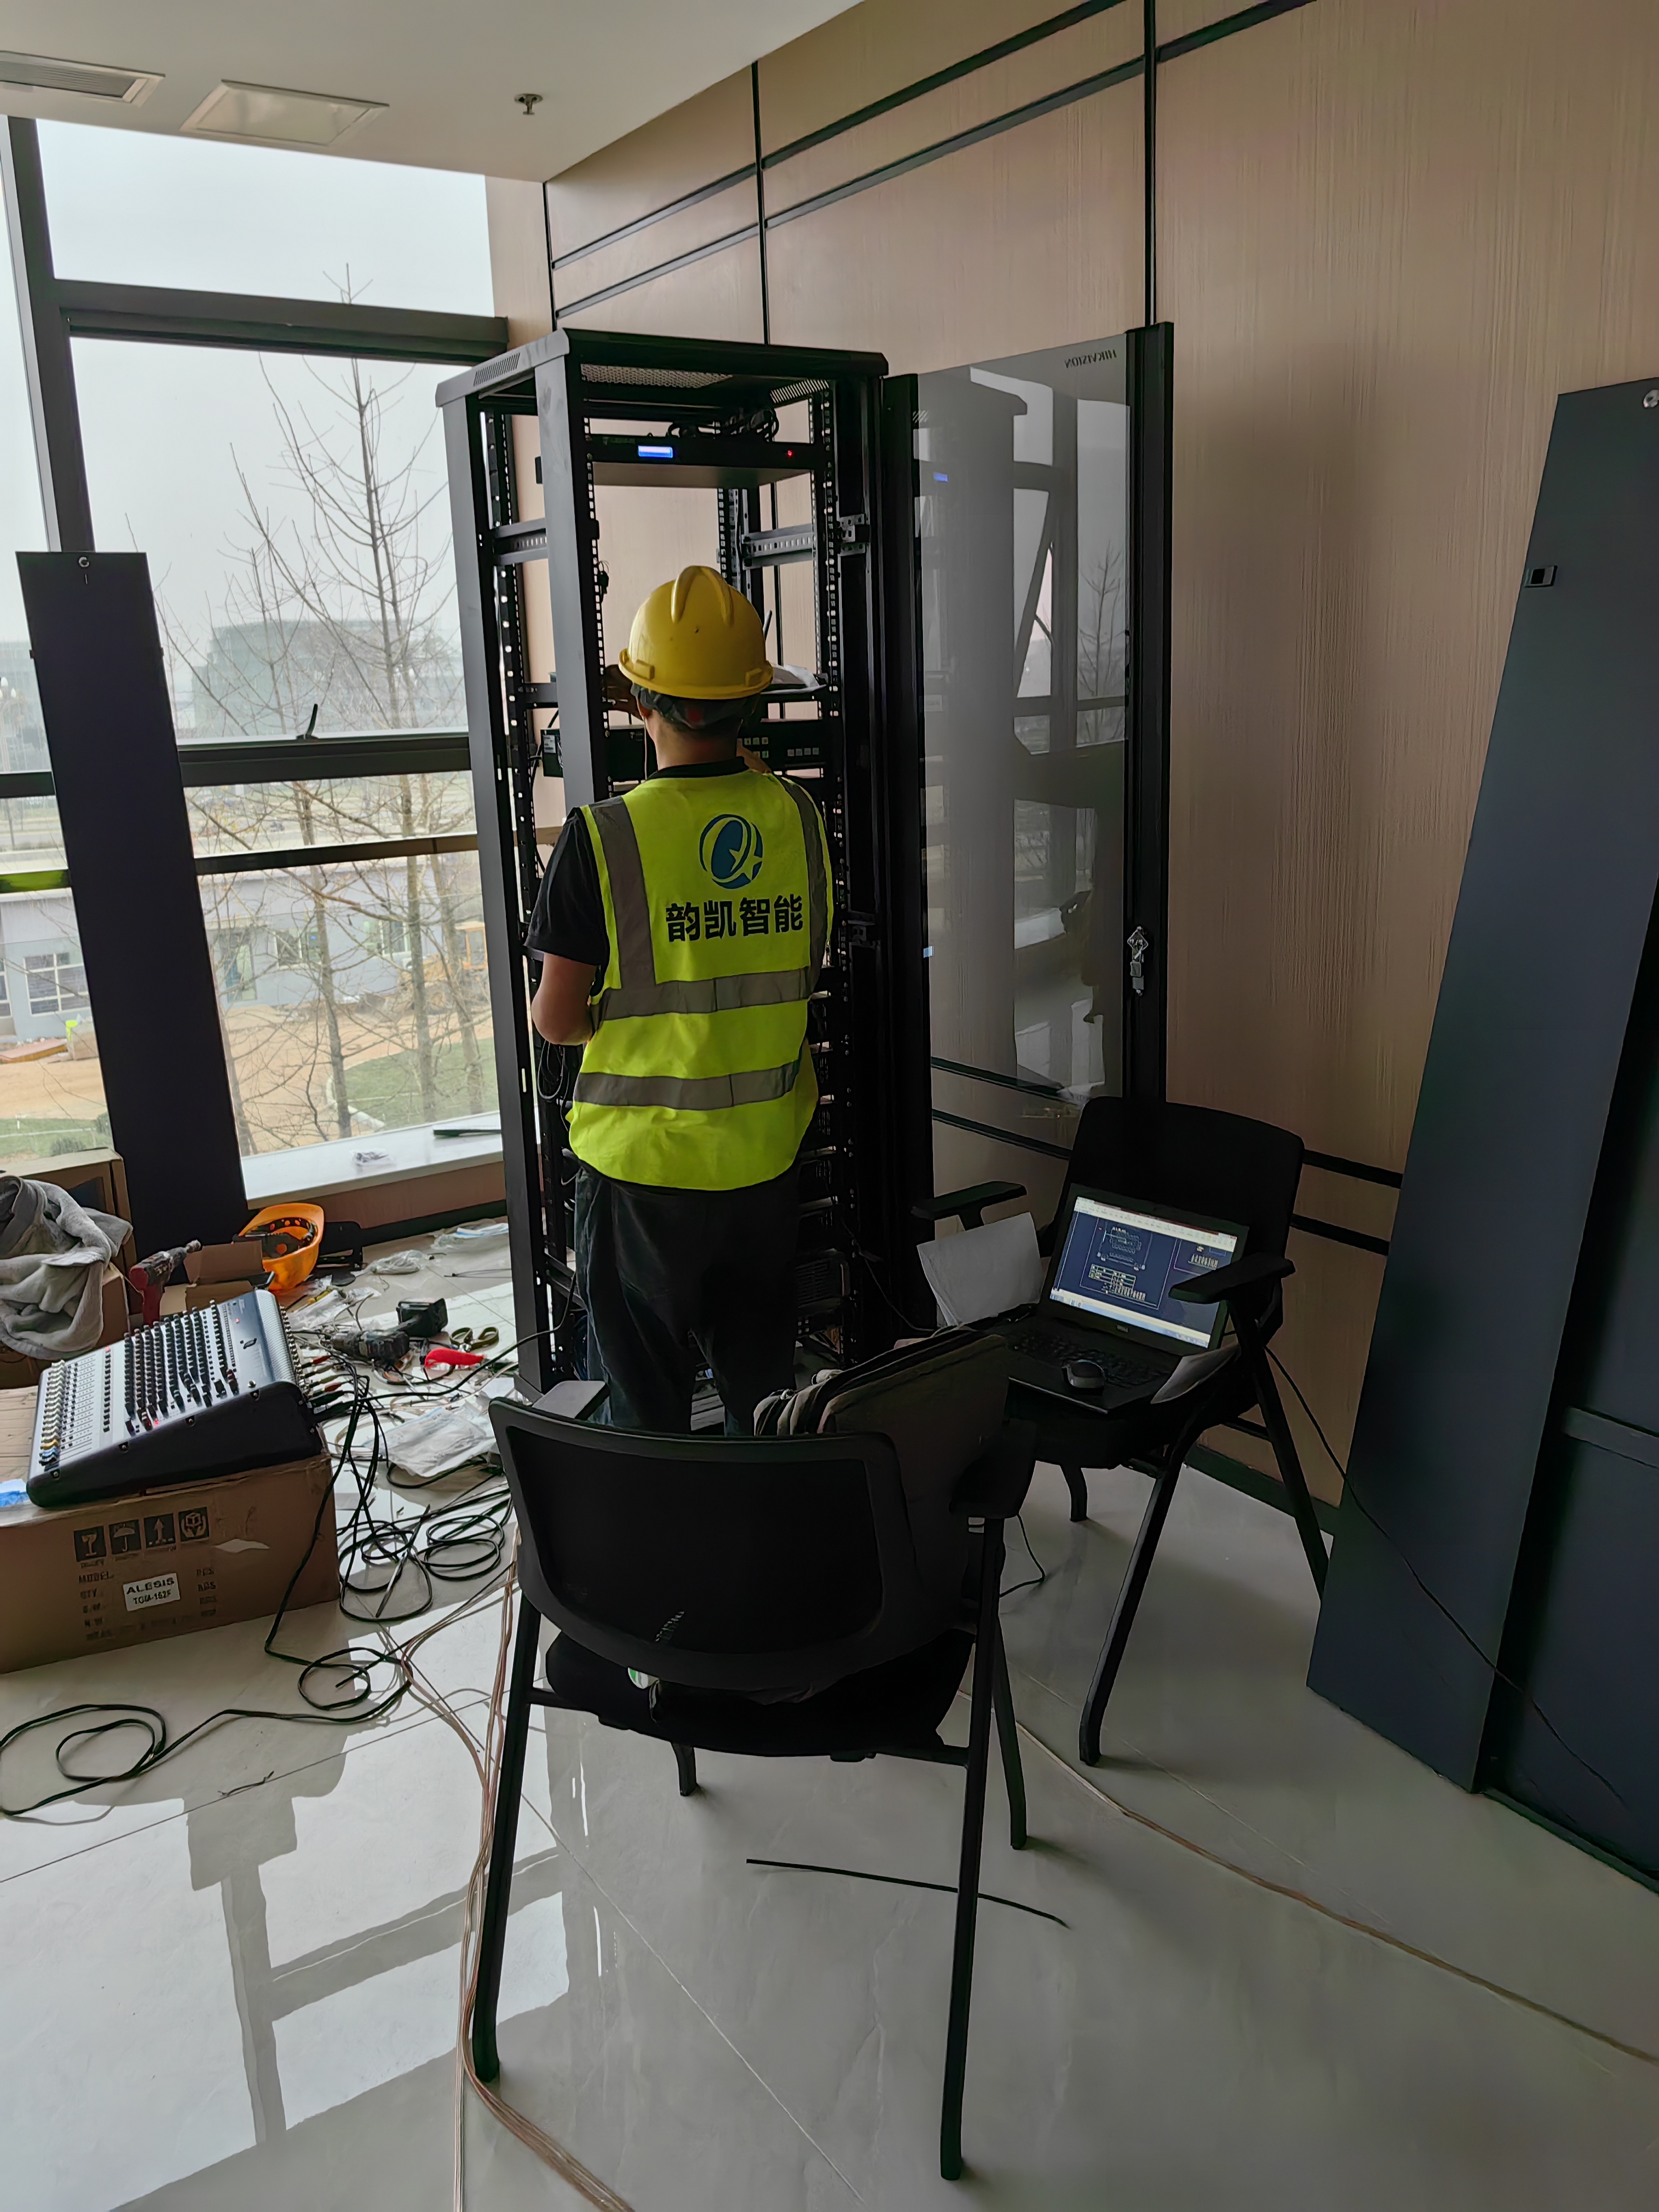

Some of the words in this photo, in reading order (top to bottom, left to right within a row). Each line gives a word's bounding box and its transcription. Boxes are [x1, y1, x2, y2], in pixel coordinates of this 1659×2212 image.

[665, 894, 803, 942] 韵凯智能
[126, 1577, 174, 1594] ALESIS
